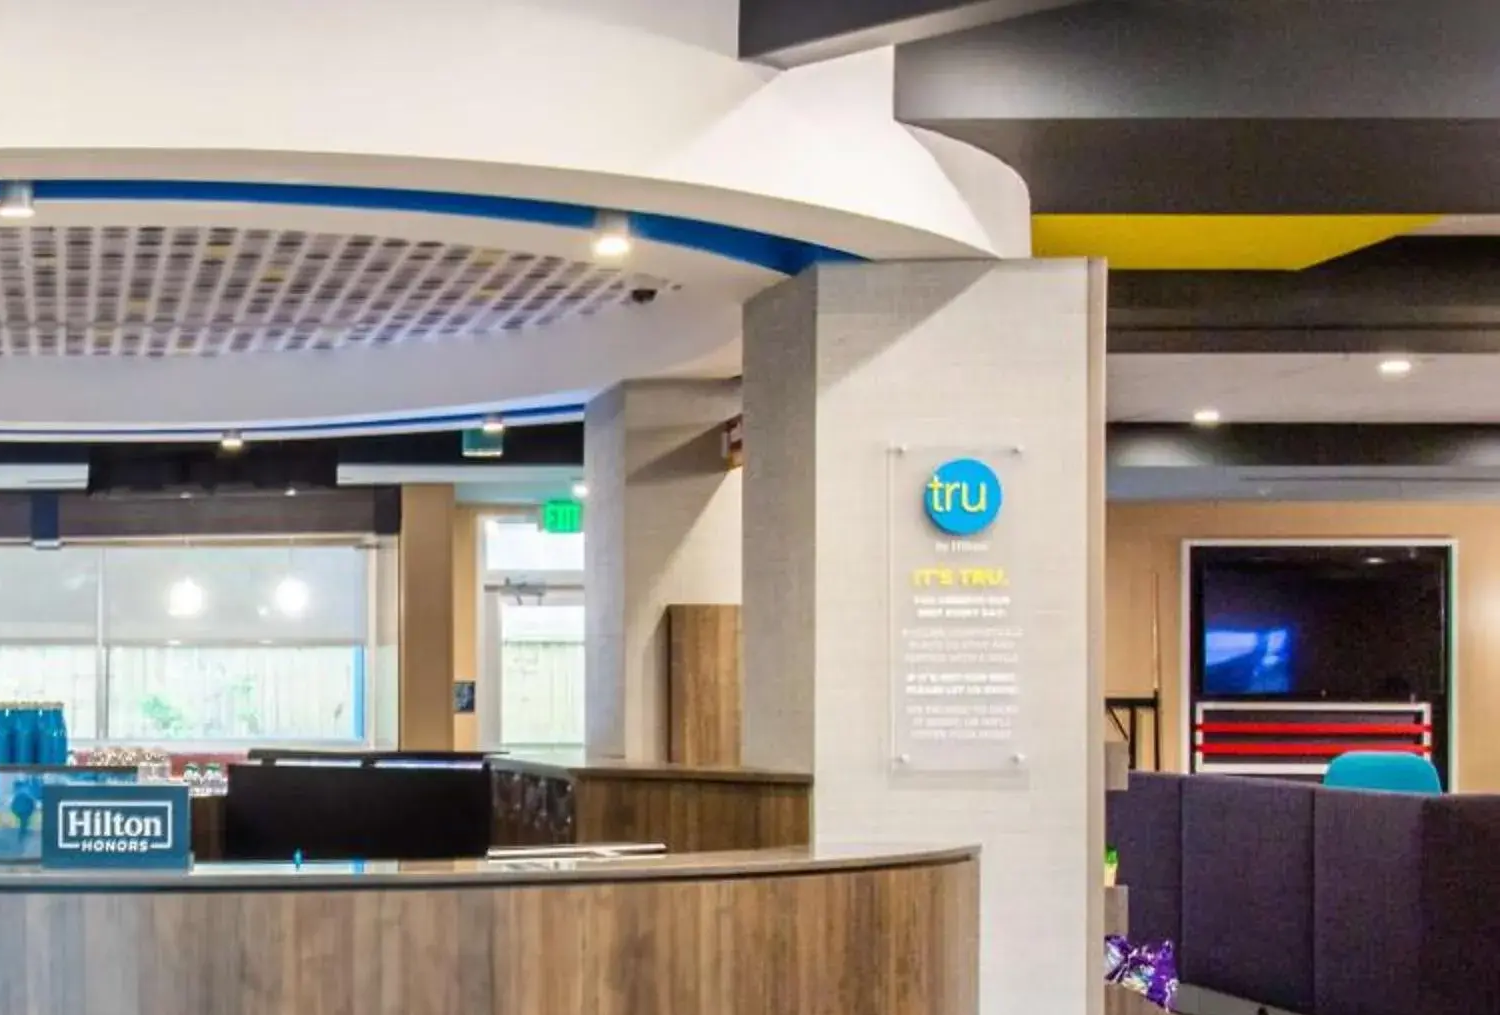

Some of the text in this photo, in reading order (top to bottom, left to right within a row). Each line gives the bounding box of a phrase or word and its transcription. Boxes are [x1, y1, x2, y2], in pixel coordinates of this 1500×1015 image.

[926, 475, 986, 512] tru
[67, 809, 162, 837] Hilton
[81, 839, 149, 852] HONORS
